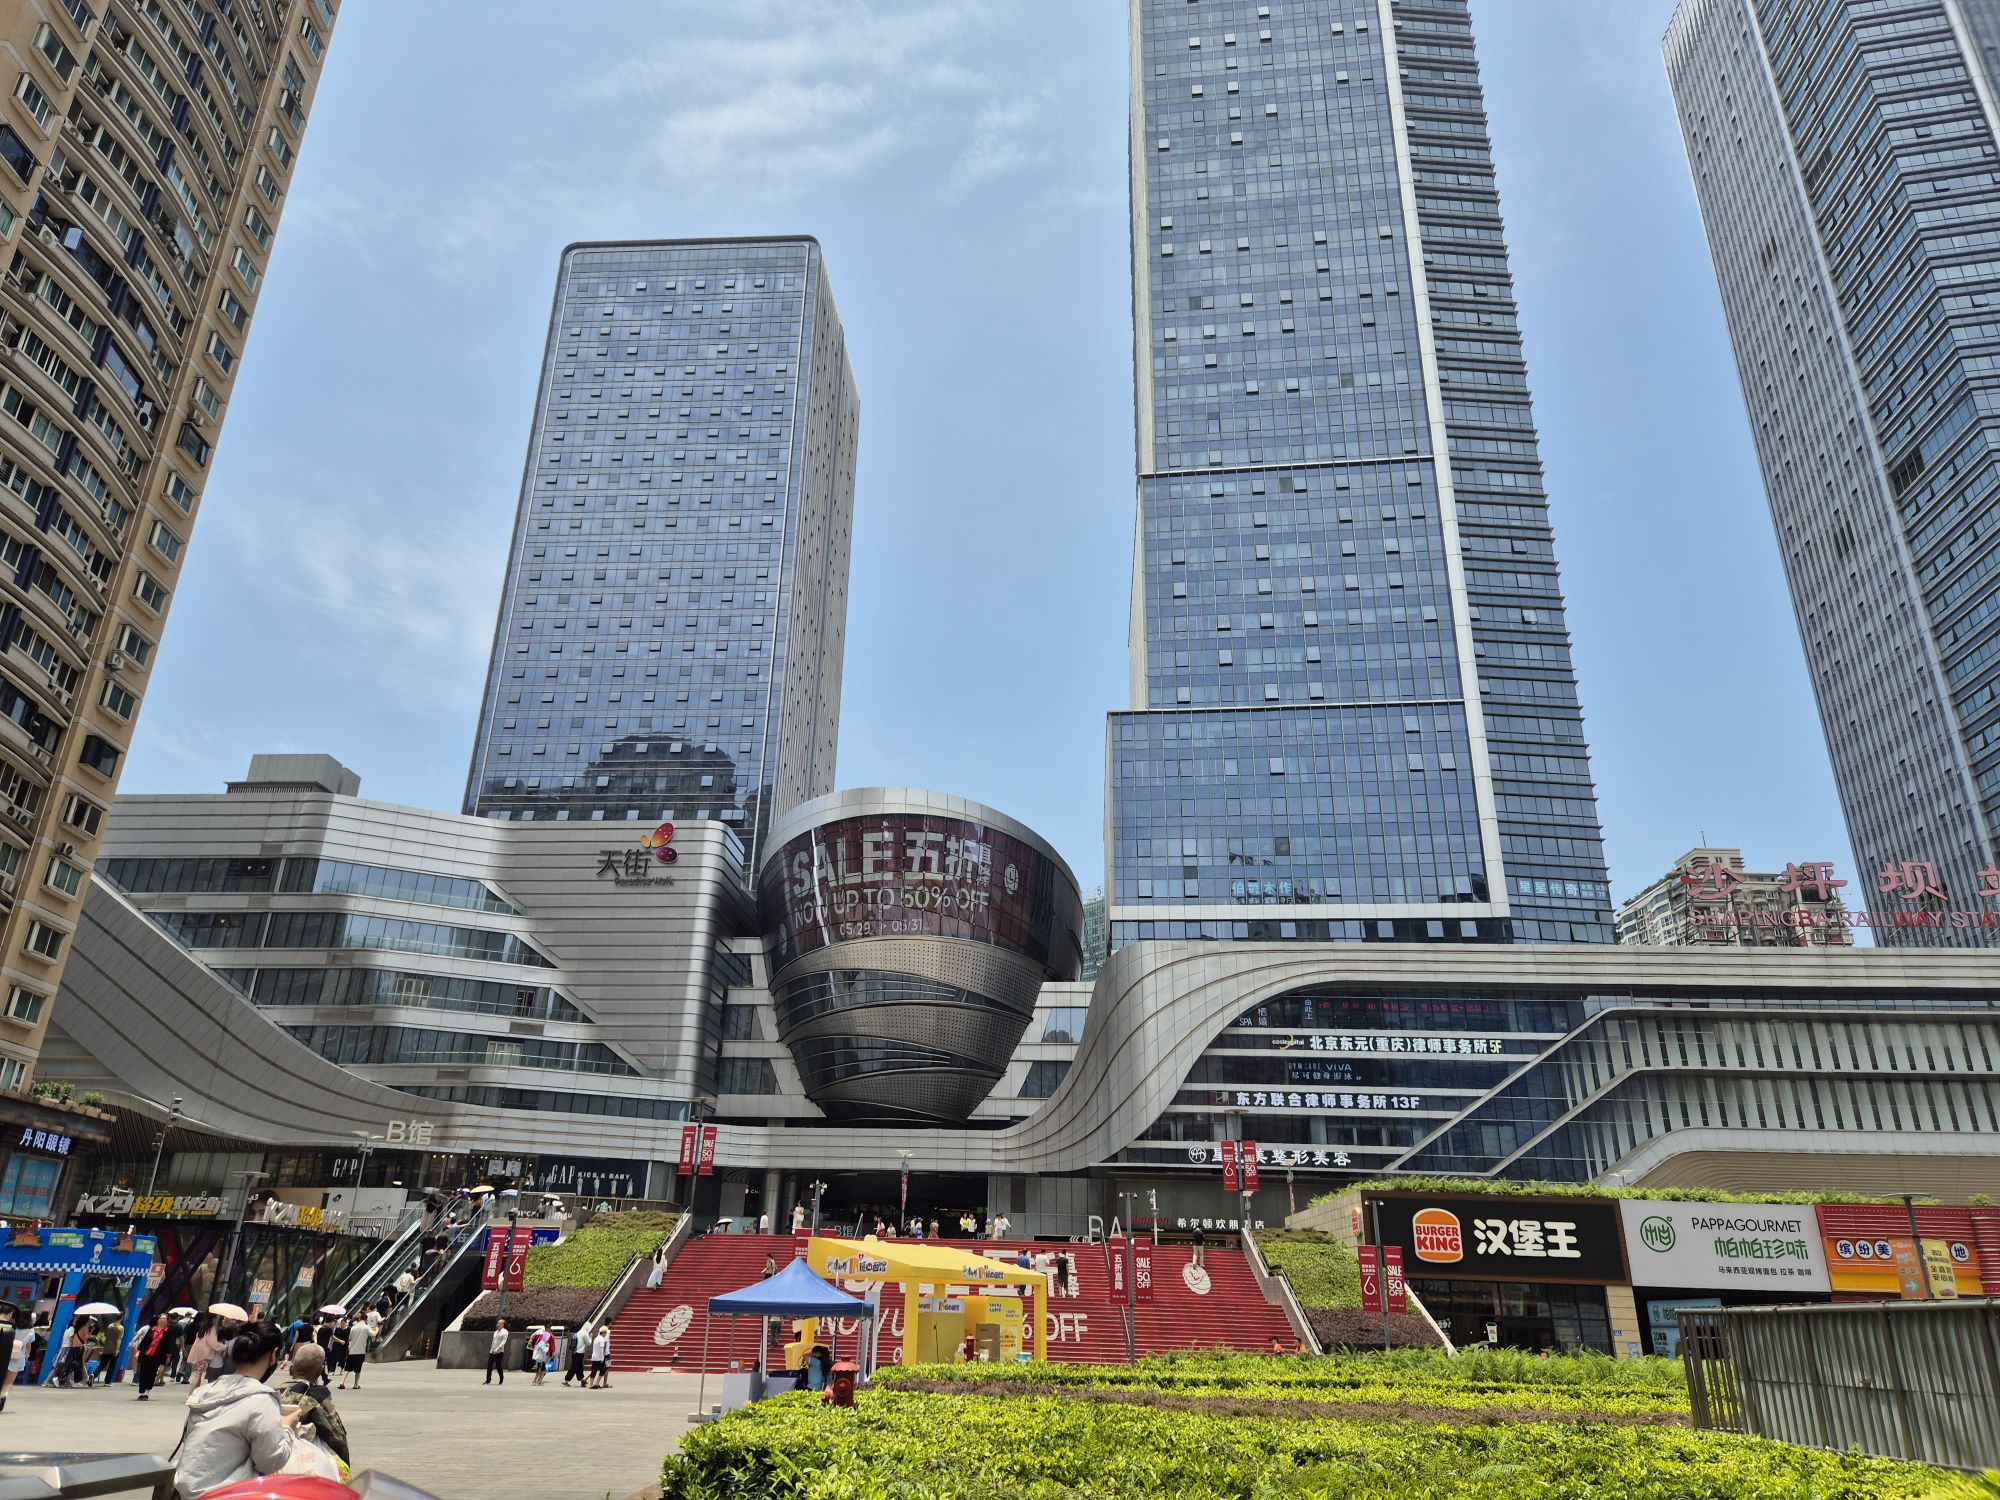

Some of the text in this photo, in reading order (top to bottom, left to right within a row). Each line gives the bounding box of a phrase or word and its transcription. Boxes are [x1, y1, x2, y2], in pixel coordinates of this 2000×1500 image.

[597, 848, 653, 877] 天街
[793, 831, 894, 897] SALE
[904, 831, 979, 883] 五折
[833, 888, 859, 914] UP
[863, 887, 895, 910] TO
[901, 885, 951, 909] 50%
[955, 887, 990, 913] OFF
[1688, 909, 1832, 928] SHAPINGBA
[1838, 910, 1942, 928] RAILWAY
[1239, 1017, 1253, 1027] SPA
[1309, 1035, 1502, 1054] 北京东元(重庆)律师事务所 5F
[1325, 1063, 1352, 1071] VIVA
[1236, 1091, 1420, 1109] 东方联合律师事务所 13F
[19, 1128, 72, 1155] 丹阳眼镜
[386, 1119, 435, 1146] B馆
[332, 1158, 358, 1178] GAP
[551, 1164, 576, 1185] GAP
[1415, 1224, 1459, 1237] BURGER
[1691, 1217, 1802, 1233] PAPPAGOURMET
[1416, 1235, 1461, 1252] KING
[1473, 1218, 1582, 1259] 汉堡王
[1713, 1237, 1809, 1260] 帕帕珍味
[486, 1242, 501, 1278] 五折直降
[1135, 1257, 1151, 1269] SALE
[1114, 1253, 1124, 1291] 五折直降
[1386, 1264, 1403, 1277] SALE
[1718, 1265, 1778, 1276] 马来西亚现烤面包
[1780, 1267, 1795, 1276] 拉茶
[1137, 1281, 1152, 1289] OFF
[1388, 1289, 1404, 1297] OFF
